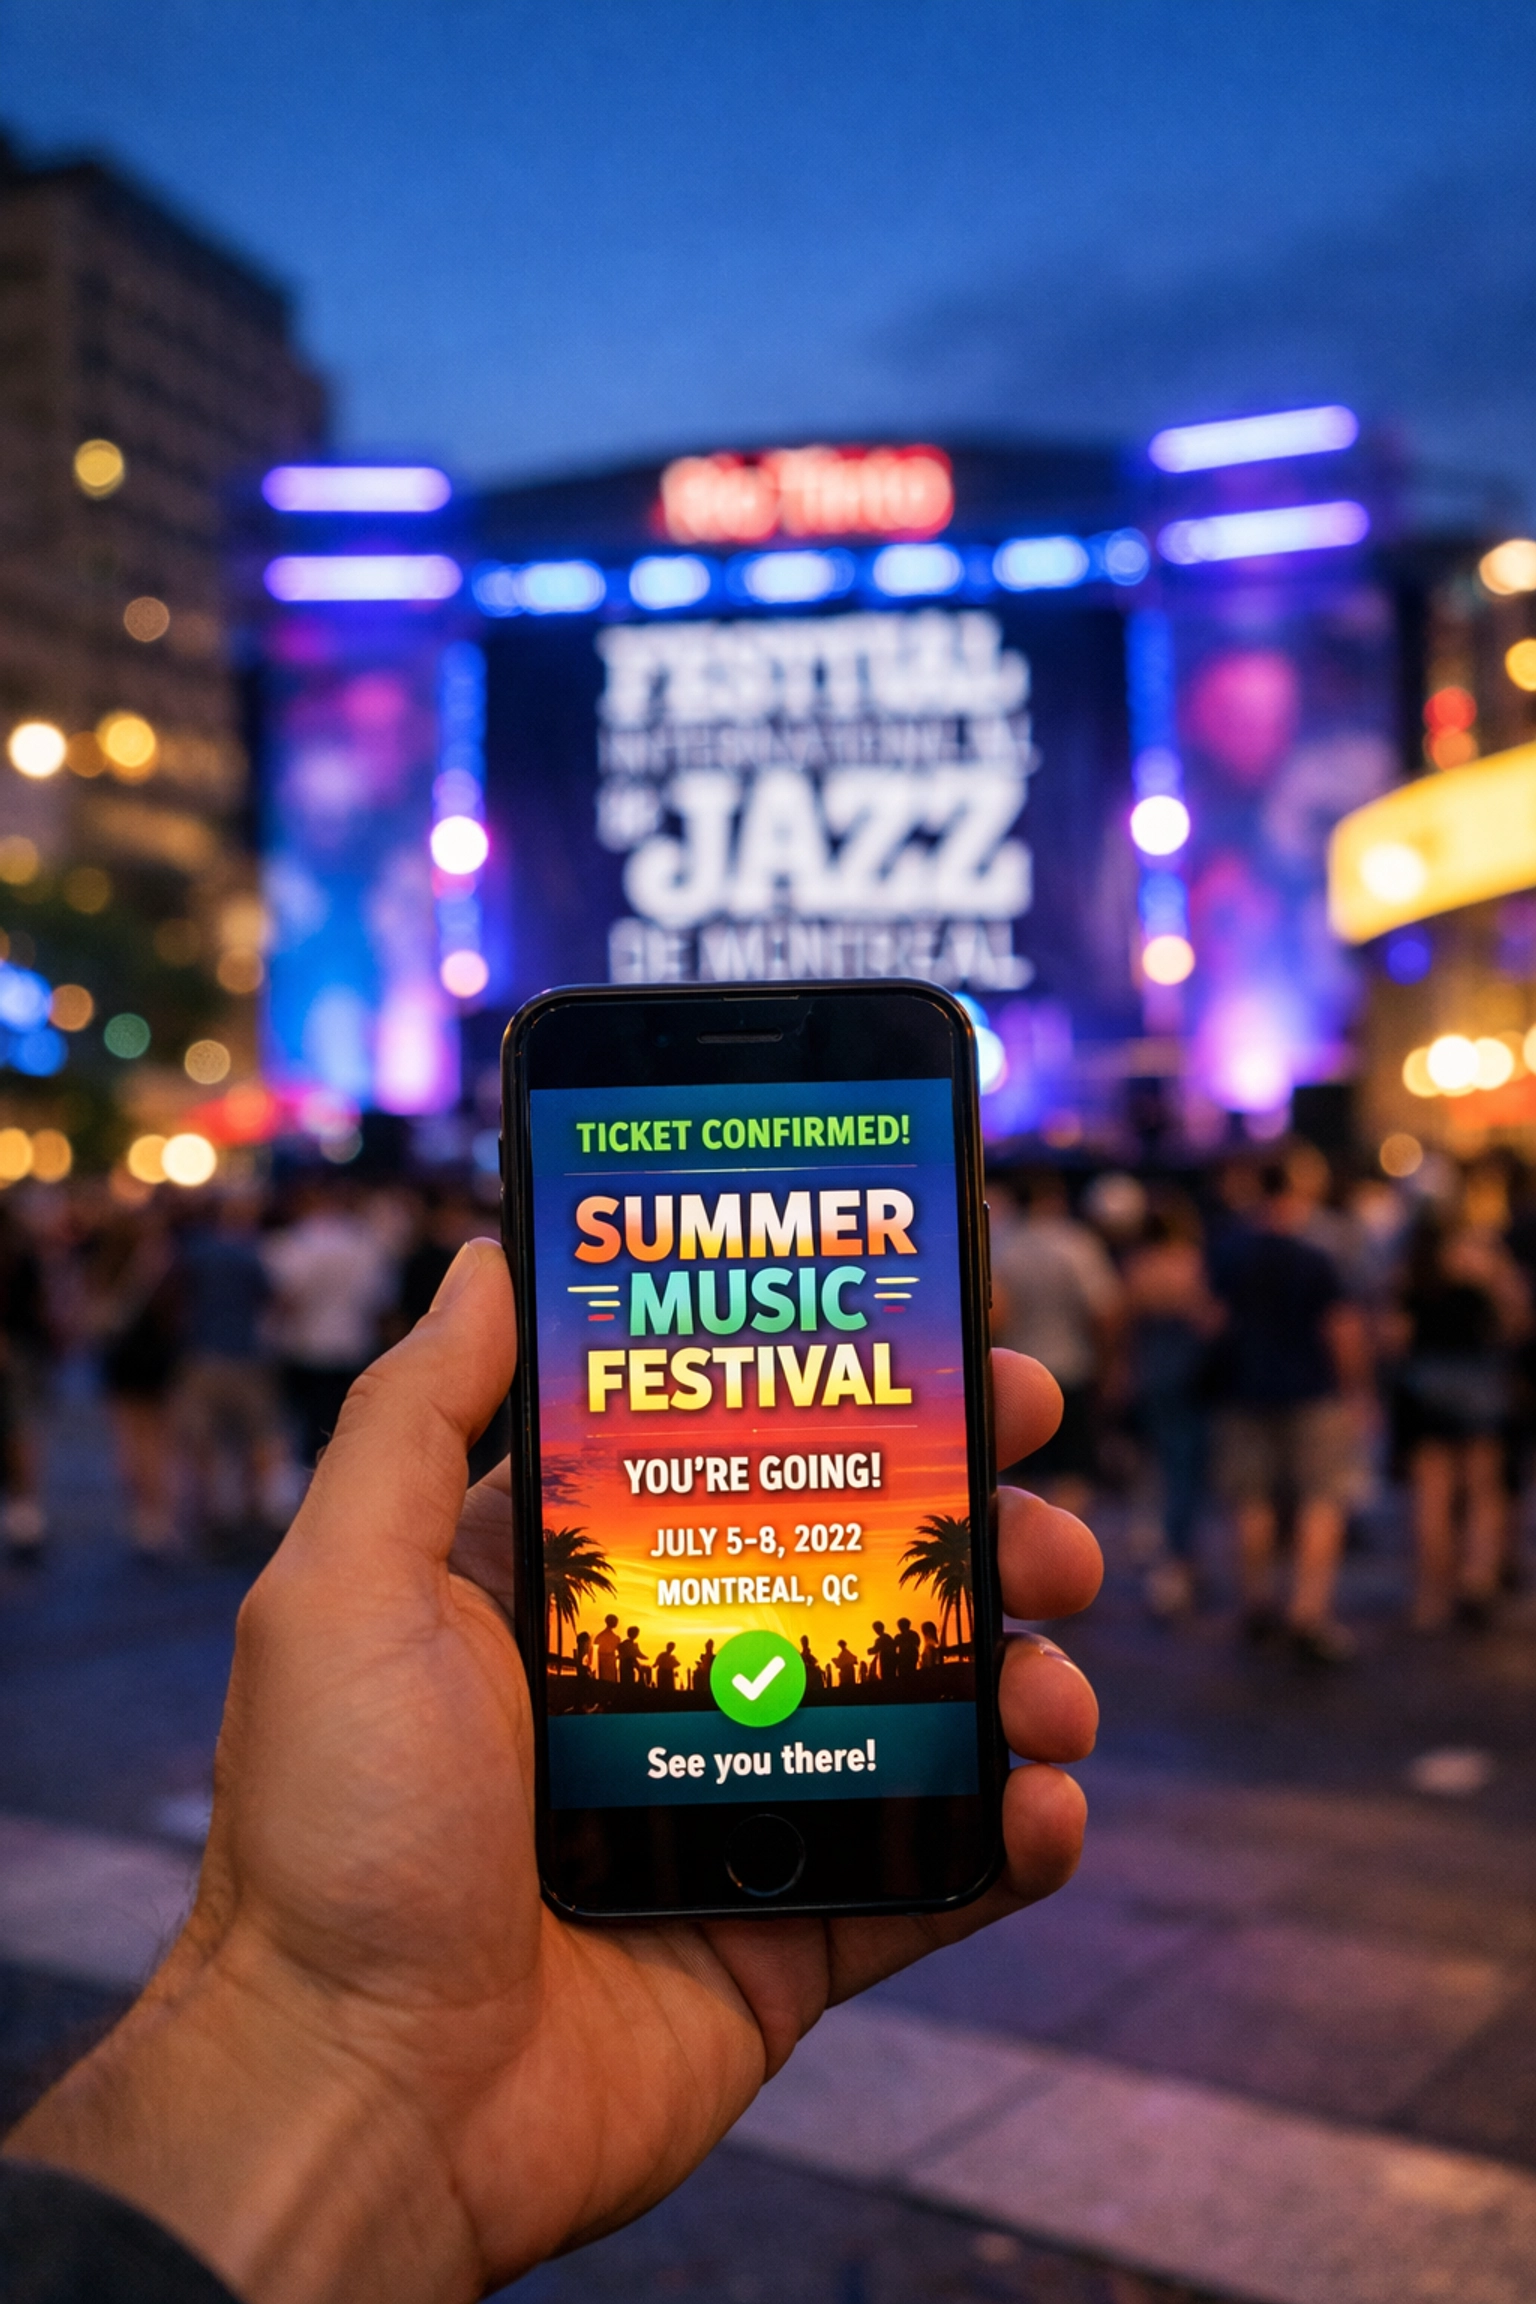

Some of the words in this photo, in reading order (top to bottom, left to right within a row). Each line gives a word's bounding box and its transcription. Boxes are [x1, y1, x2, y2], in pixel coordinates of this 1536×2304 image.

[624, 765, 1032, 928] JAZZ
[576, 1120, 692, 1153] TICKET
[702, 1115, 910, 1149] CONFIRMED!
[574, 1188, 918, 1264] SUMMER
[629, 1265, 868, 1336] MUSIC
[587, 1342, 912, 1412] FESTIVAL
[624, 1455, 750, 1495] YOU'RE
[759, 1452, 883, 1491] GOING!
[651, 1527, 718, 1557] JULY
[726, 1525, 785, 1559] 5-8,
[794, 1523, 862, 1553] 2022
[657, 1576, 814, 1607] MONTREAL,
[822, 1574, 859, 1604] QC
[647, 1746, 705, 1779] See
[714, 1752, 771, 1785] you
[781, 1739, 877, 1774] there!
